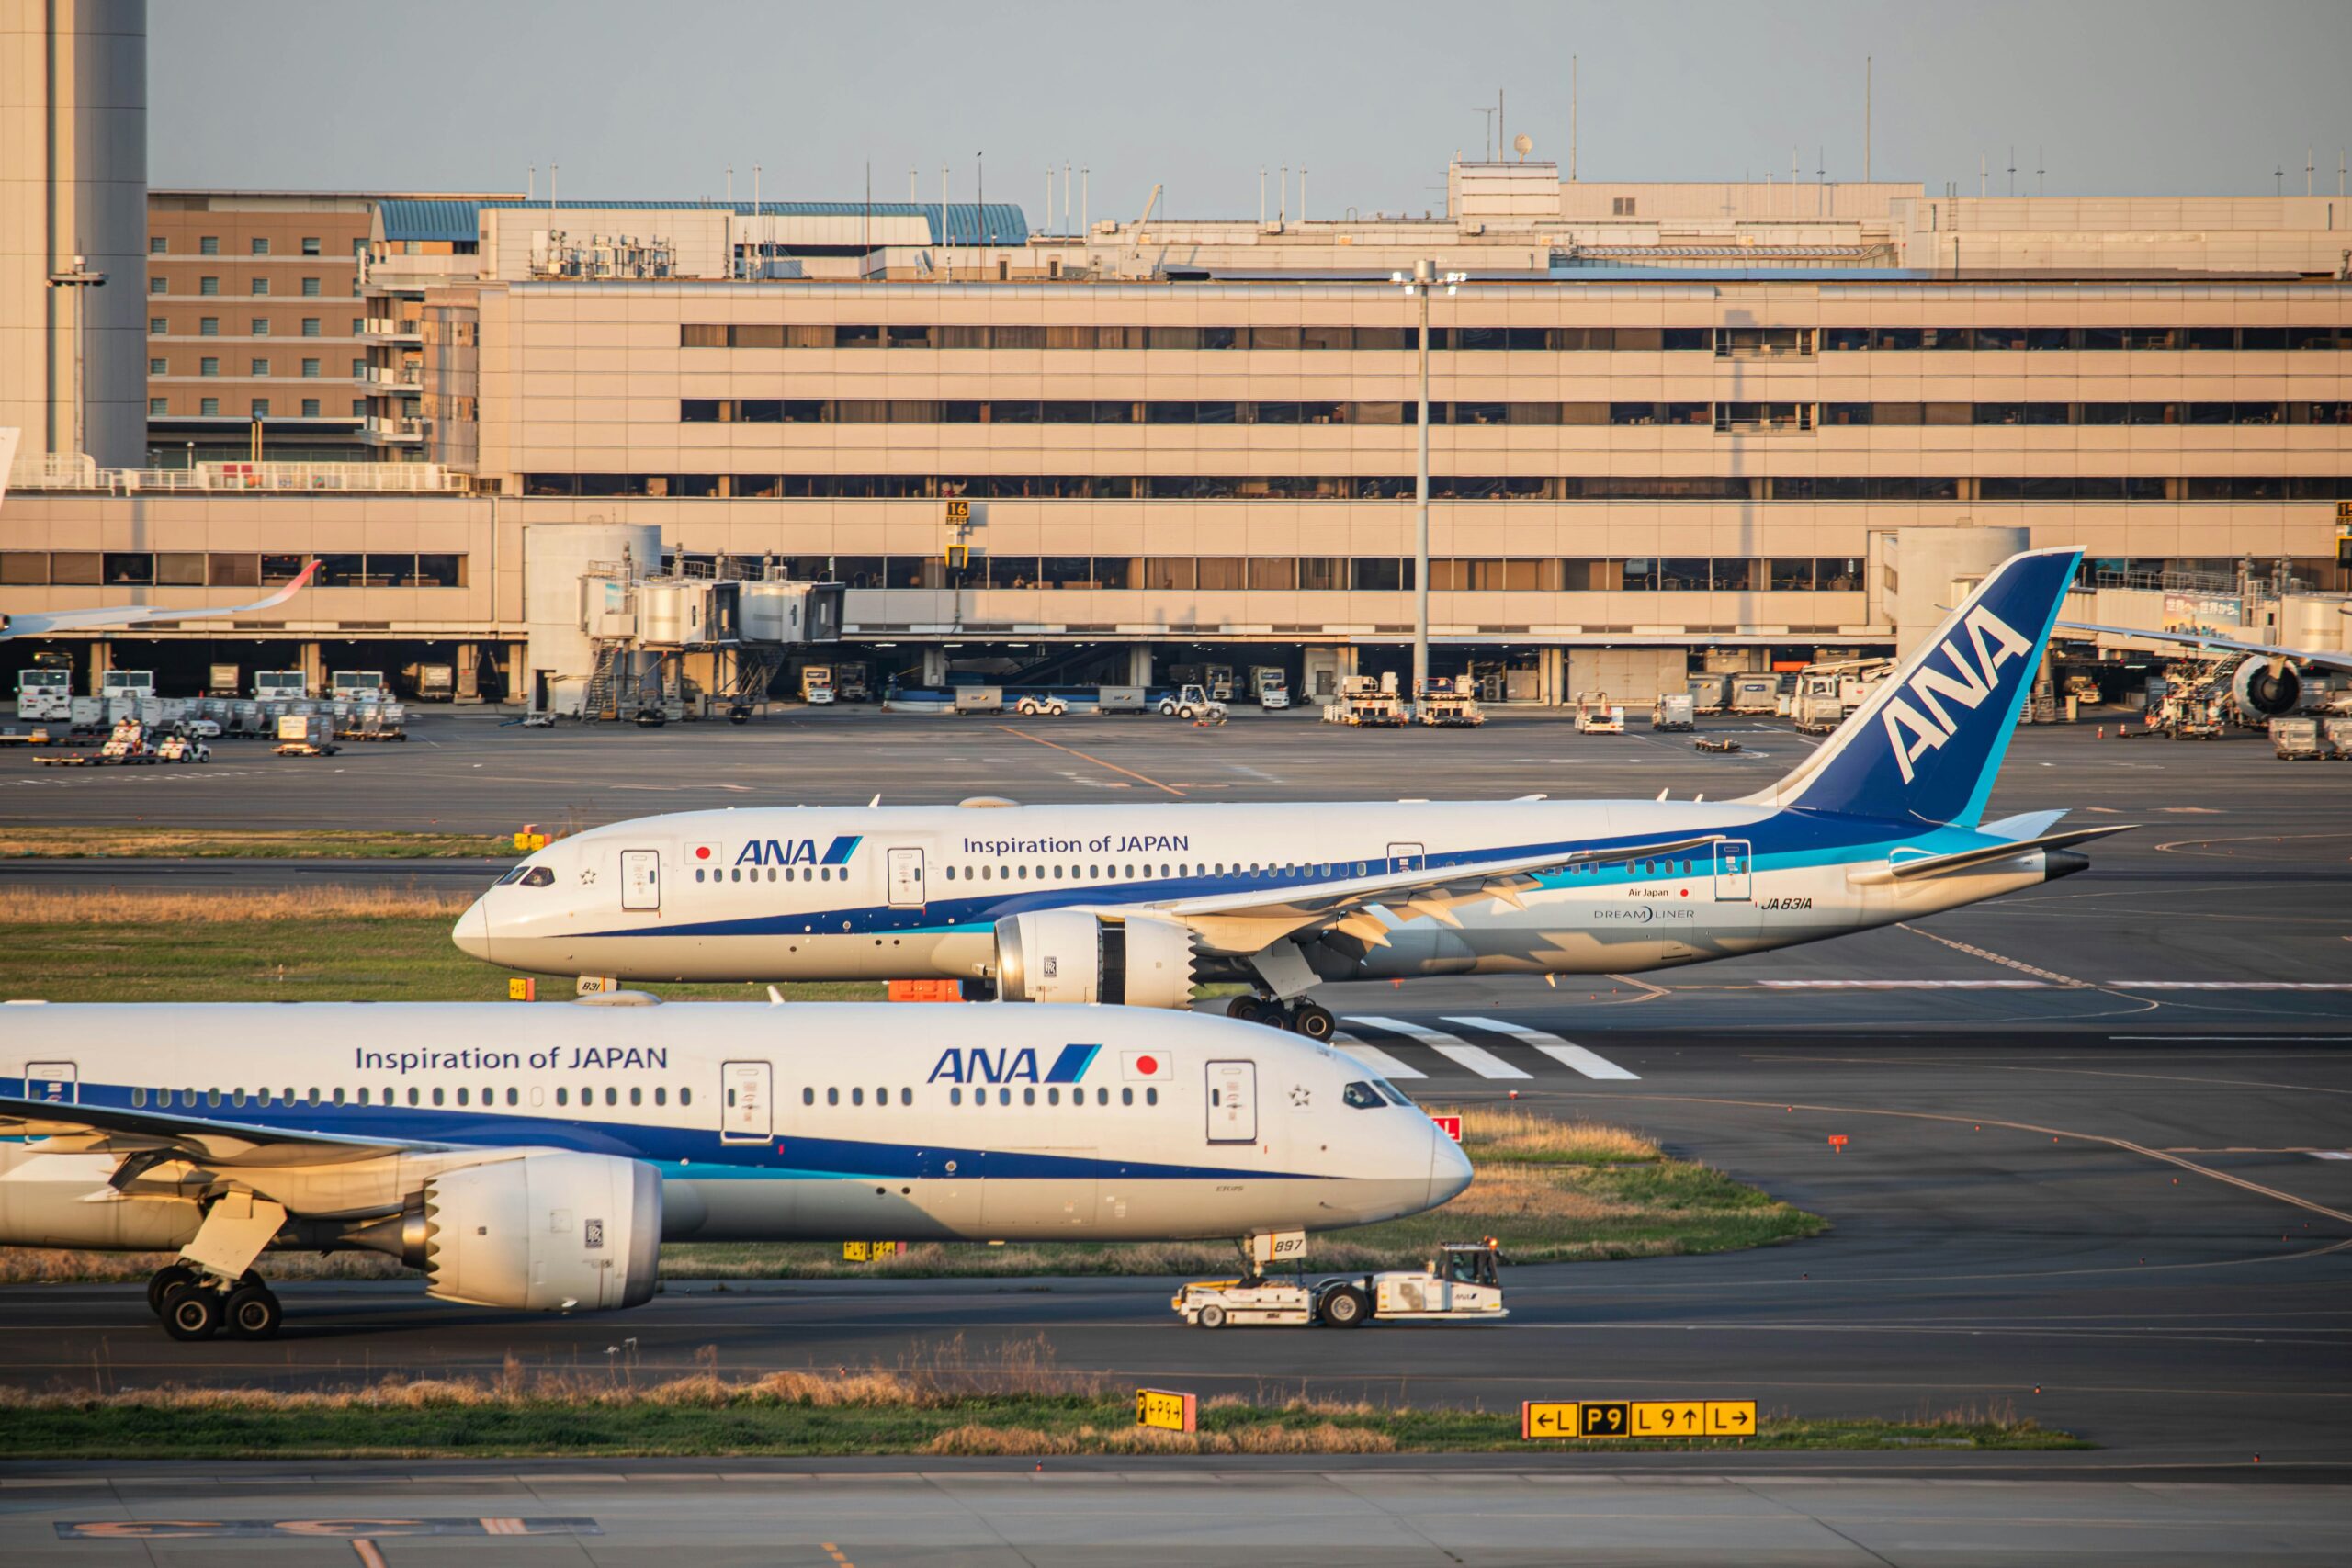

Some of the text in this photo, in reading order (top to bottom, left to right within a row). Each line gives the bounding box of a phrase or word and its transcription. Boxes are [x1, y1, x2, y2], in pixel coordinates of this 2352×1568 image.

[951, 503, 967, 515] 16
[1882, 604, 2033, 785] ANA
[735, 840, 817, 866] ANA
[964, 835, 1189, 857] Inspiration of JAPAN
[1628, 888, 1669, 898] Air Japan
[1761, 897, 1813, 910] JA831A
[582, 981, 601, 991] 831
[356, 1046, 667, 1075] Inspiration of JAPAN
[927, 1048, 1039, 1084] ANA
[1275, 1239, 1303, 1253] 897
[1158, 1400, 1171, 1422] P9
[1557, 1410, 1569, 1430] L
[1587, 1408, 1623, 1432] P9
[1715, 1408, 1728, 1429] L
